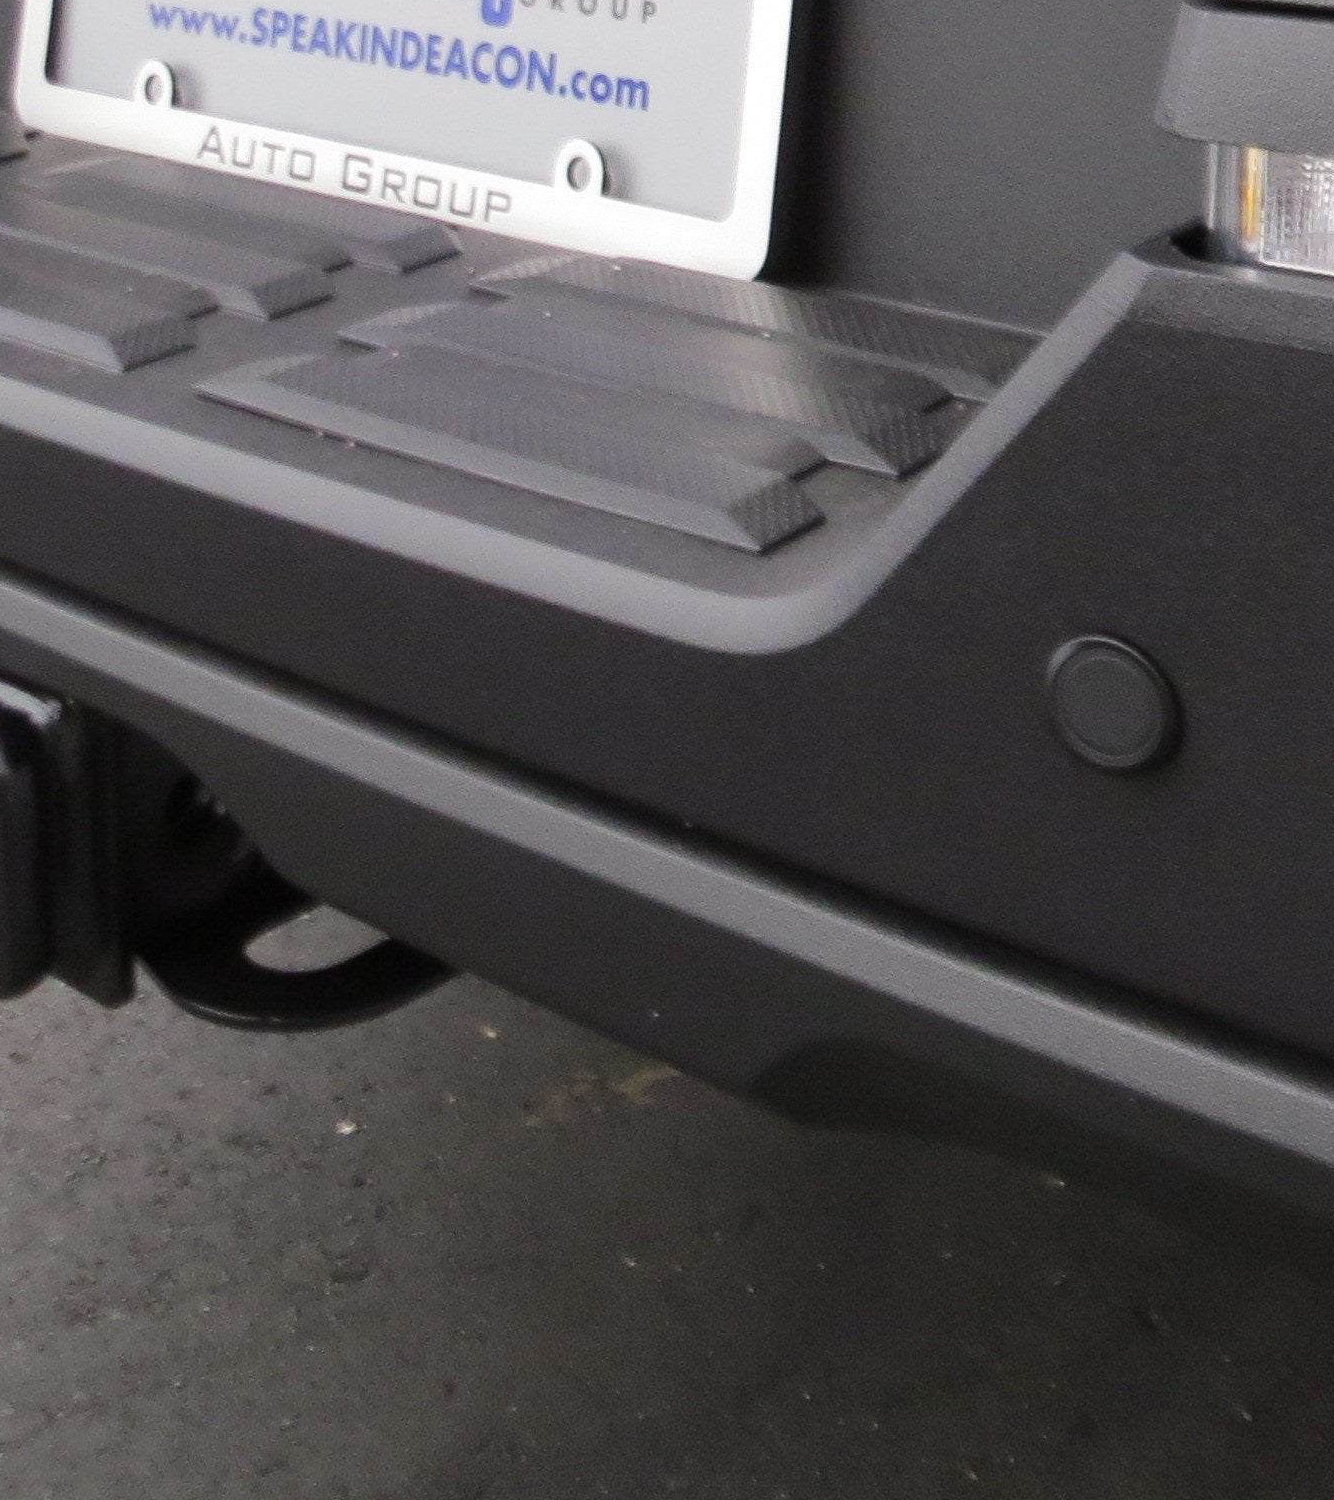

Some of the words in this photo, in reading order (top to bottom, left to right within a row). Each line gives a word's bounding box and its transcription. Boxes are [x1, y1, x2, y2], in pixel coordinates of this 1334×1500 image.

[147, 2, 651, 110] www.SPEAKINDEACON.com
[197, 126, 316, 182] AUTO
[342, 153, 513, 222] GROUP
